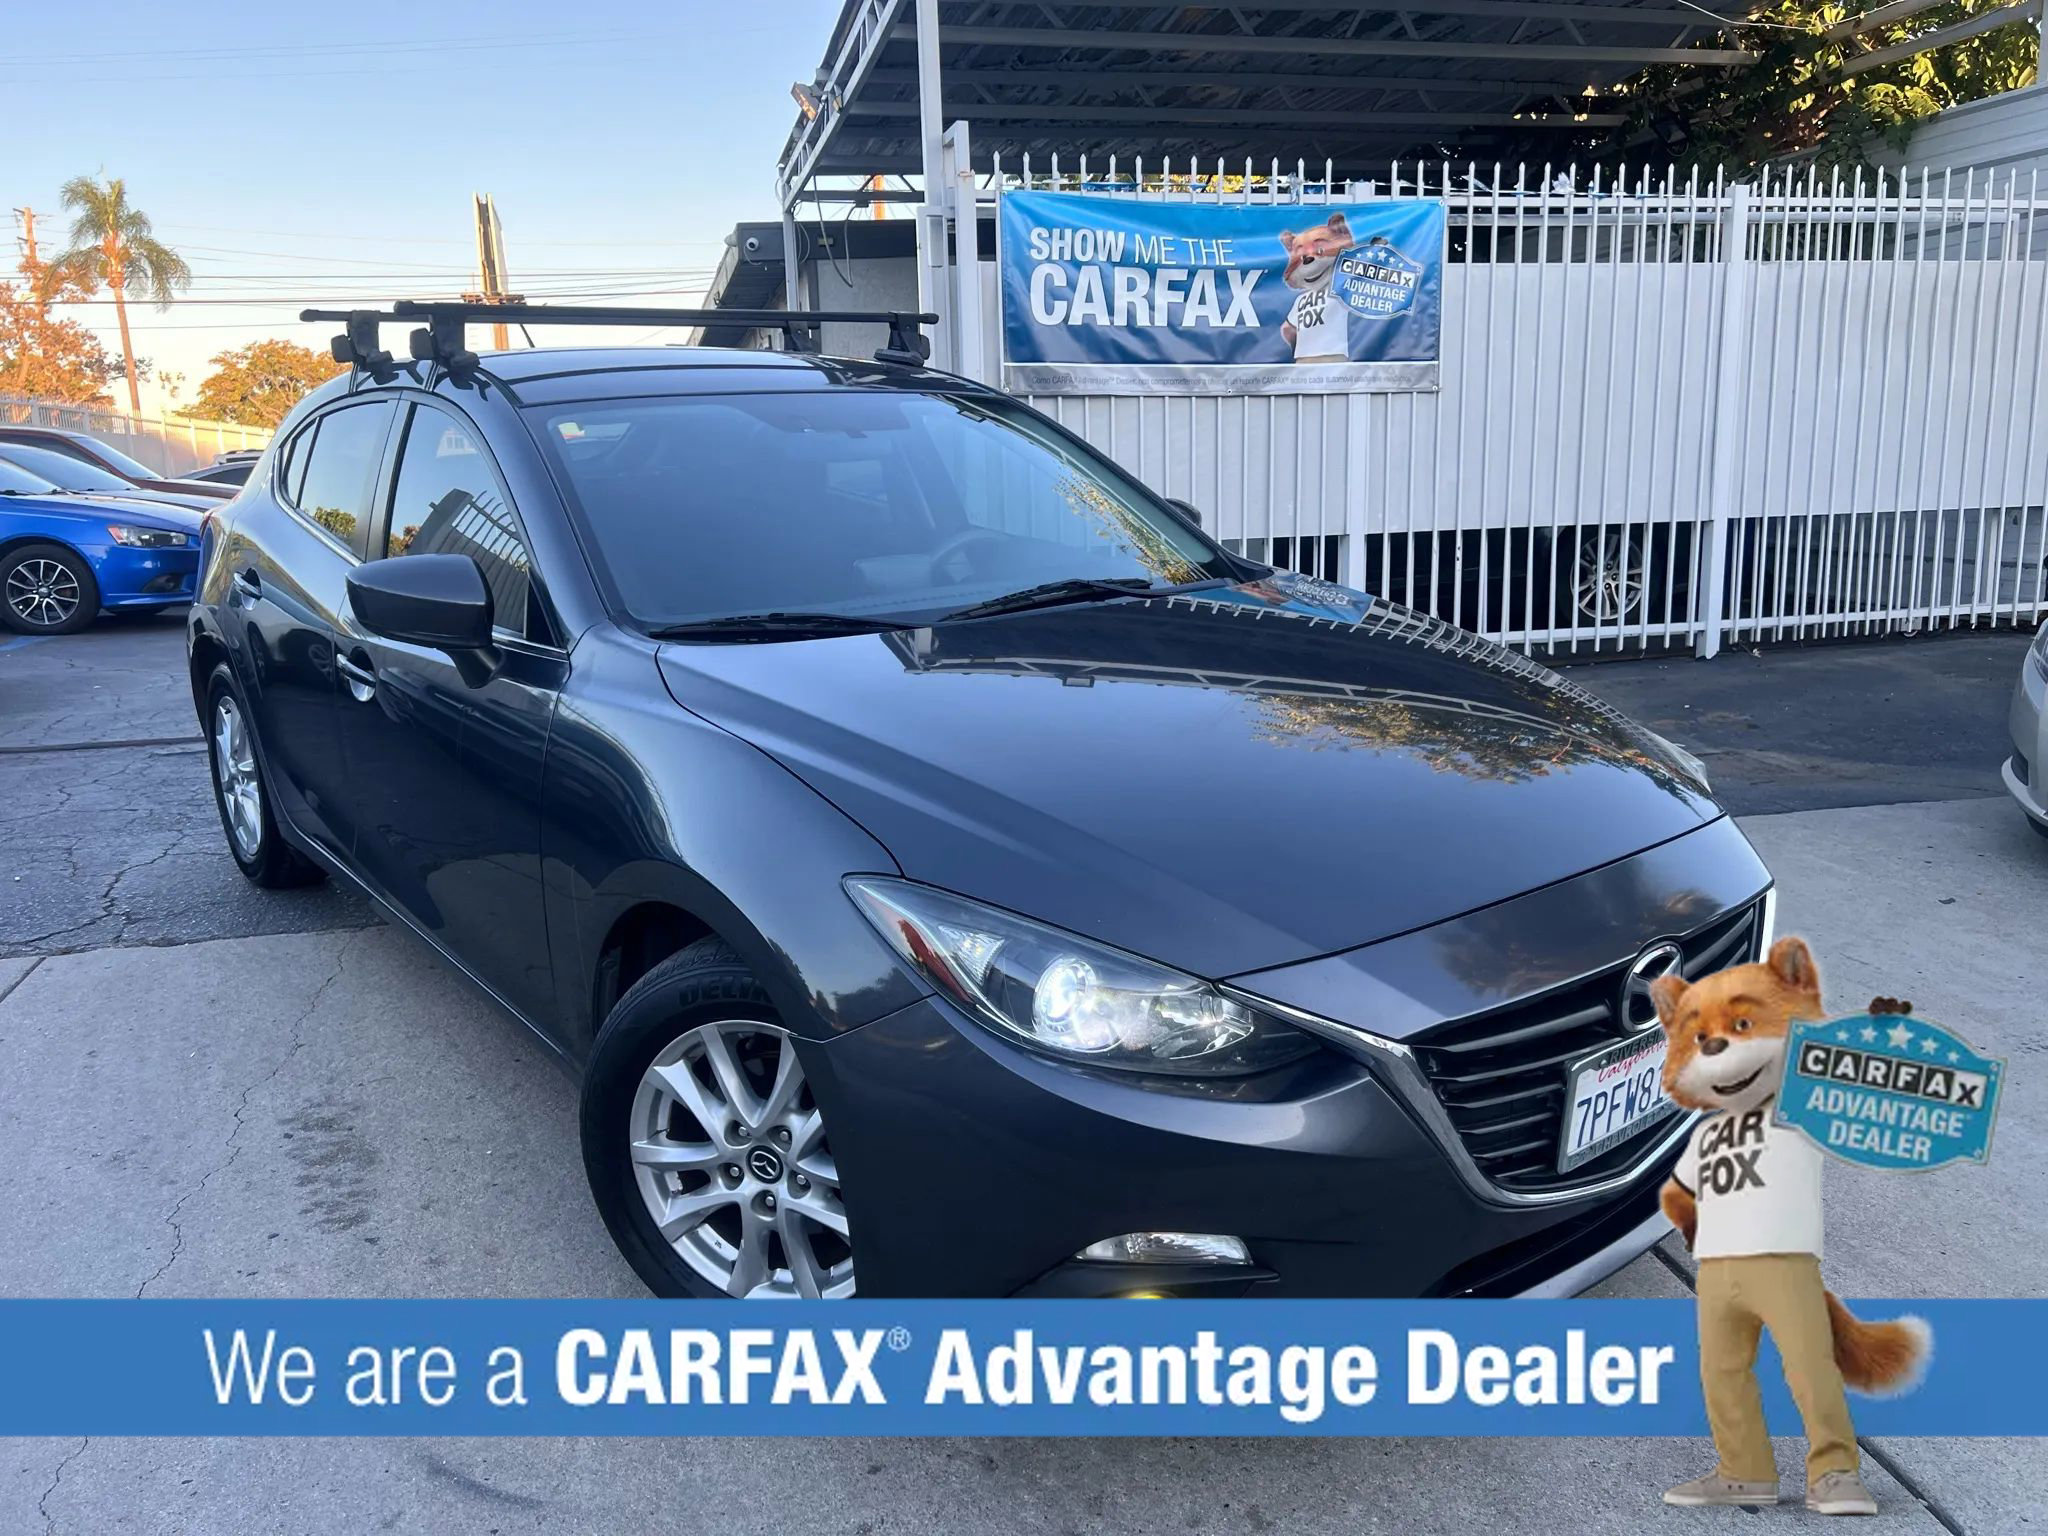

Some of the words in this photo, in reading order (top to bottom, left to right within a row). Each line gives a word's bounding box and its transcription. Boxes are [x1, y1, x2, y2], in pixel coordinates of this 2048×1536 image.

[1029, 226, 1126, 262] SHOW
[1134, 233, 1177, 265] ME
[1181, 237, 1236, 266] THE
[1341, 260, 1412, 288] CARFAX
[1029, 262, 1264, 328] CARFAX
[1297, 289, 1326, 312] CAR
[1343, 278, 1407, 302] ADVANTAGE
[1350, 294, 1393, 313] DEALER
[1297, 307, 1325, 332] FOX
